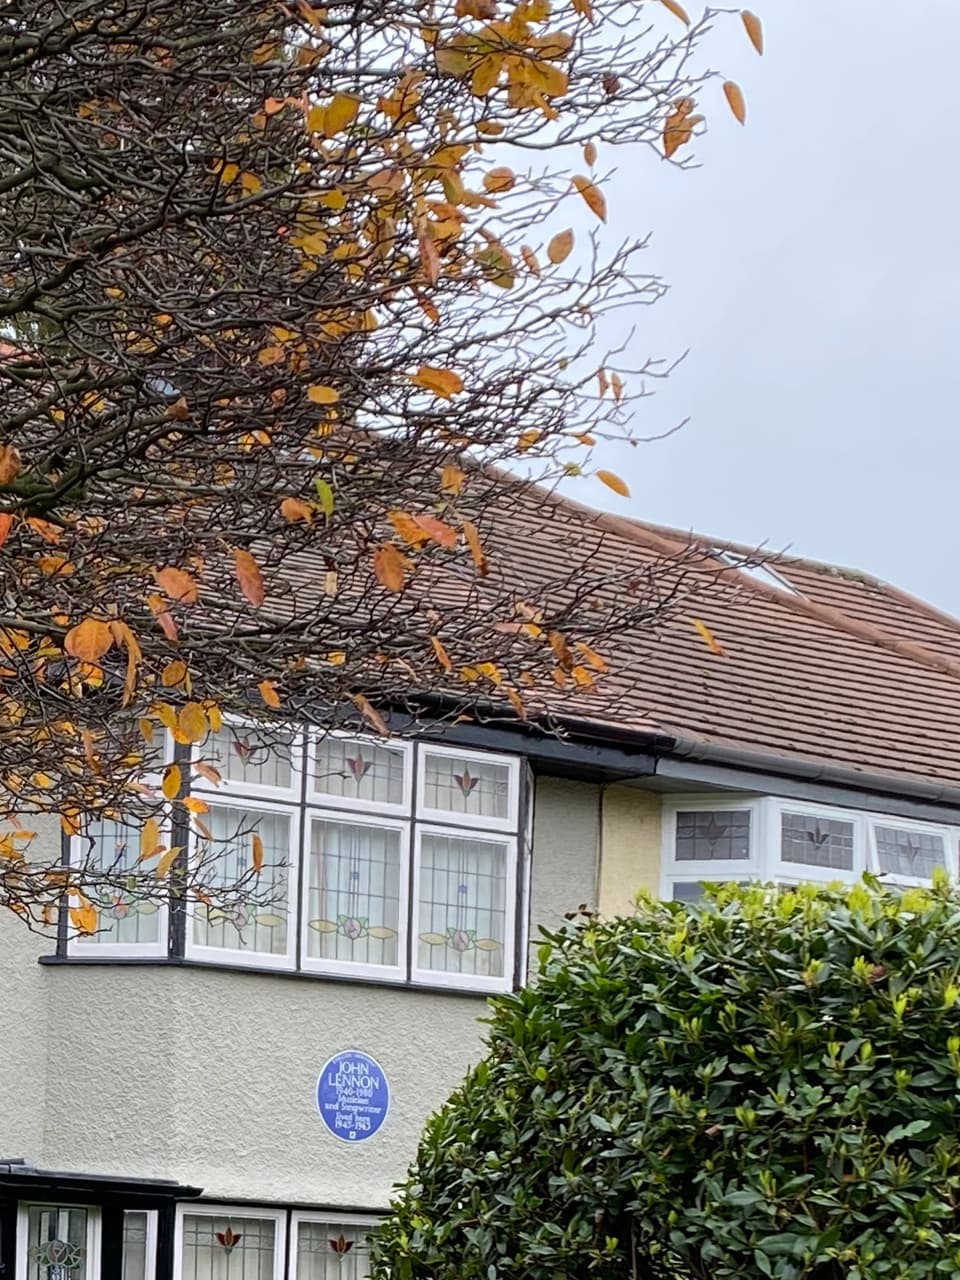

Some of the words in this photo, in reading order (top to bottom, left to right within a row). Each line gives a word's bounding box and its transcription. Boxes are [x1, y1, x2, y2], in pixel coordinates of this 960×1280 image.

[339, 1060, 370, 1074] JOHN
[328, 1072, 380, 1089] LENNON
[324, 1102, 338, 1110] and
